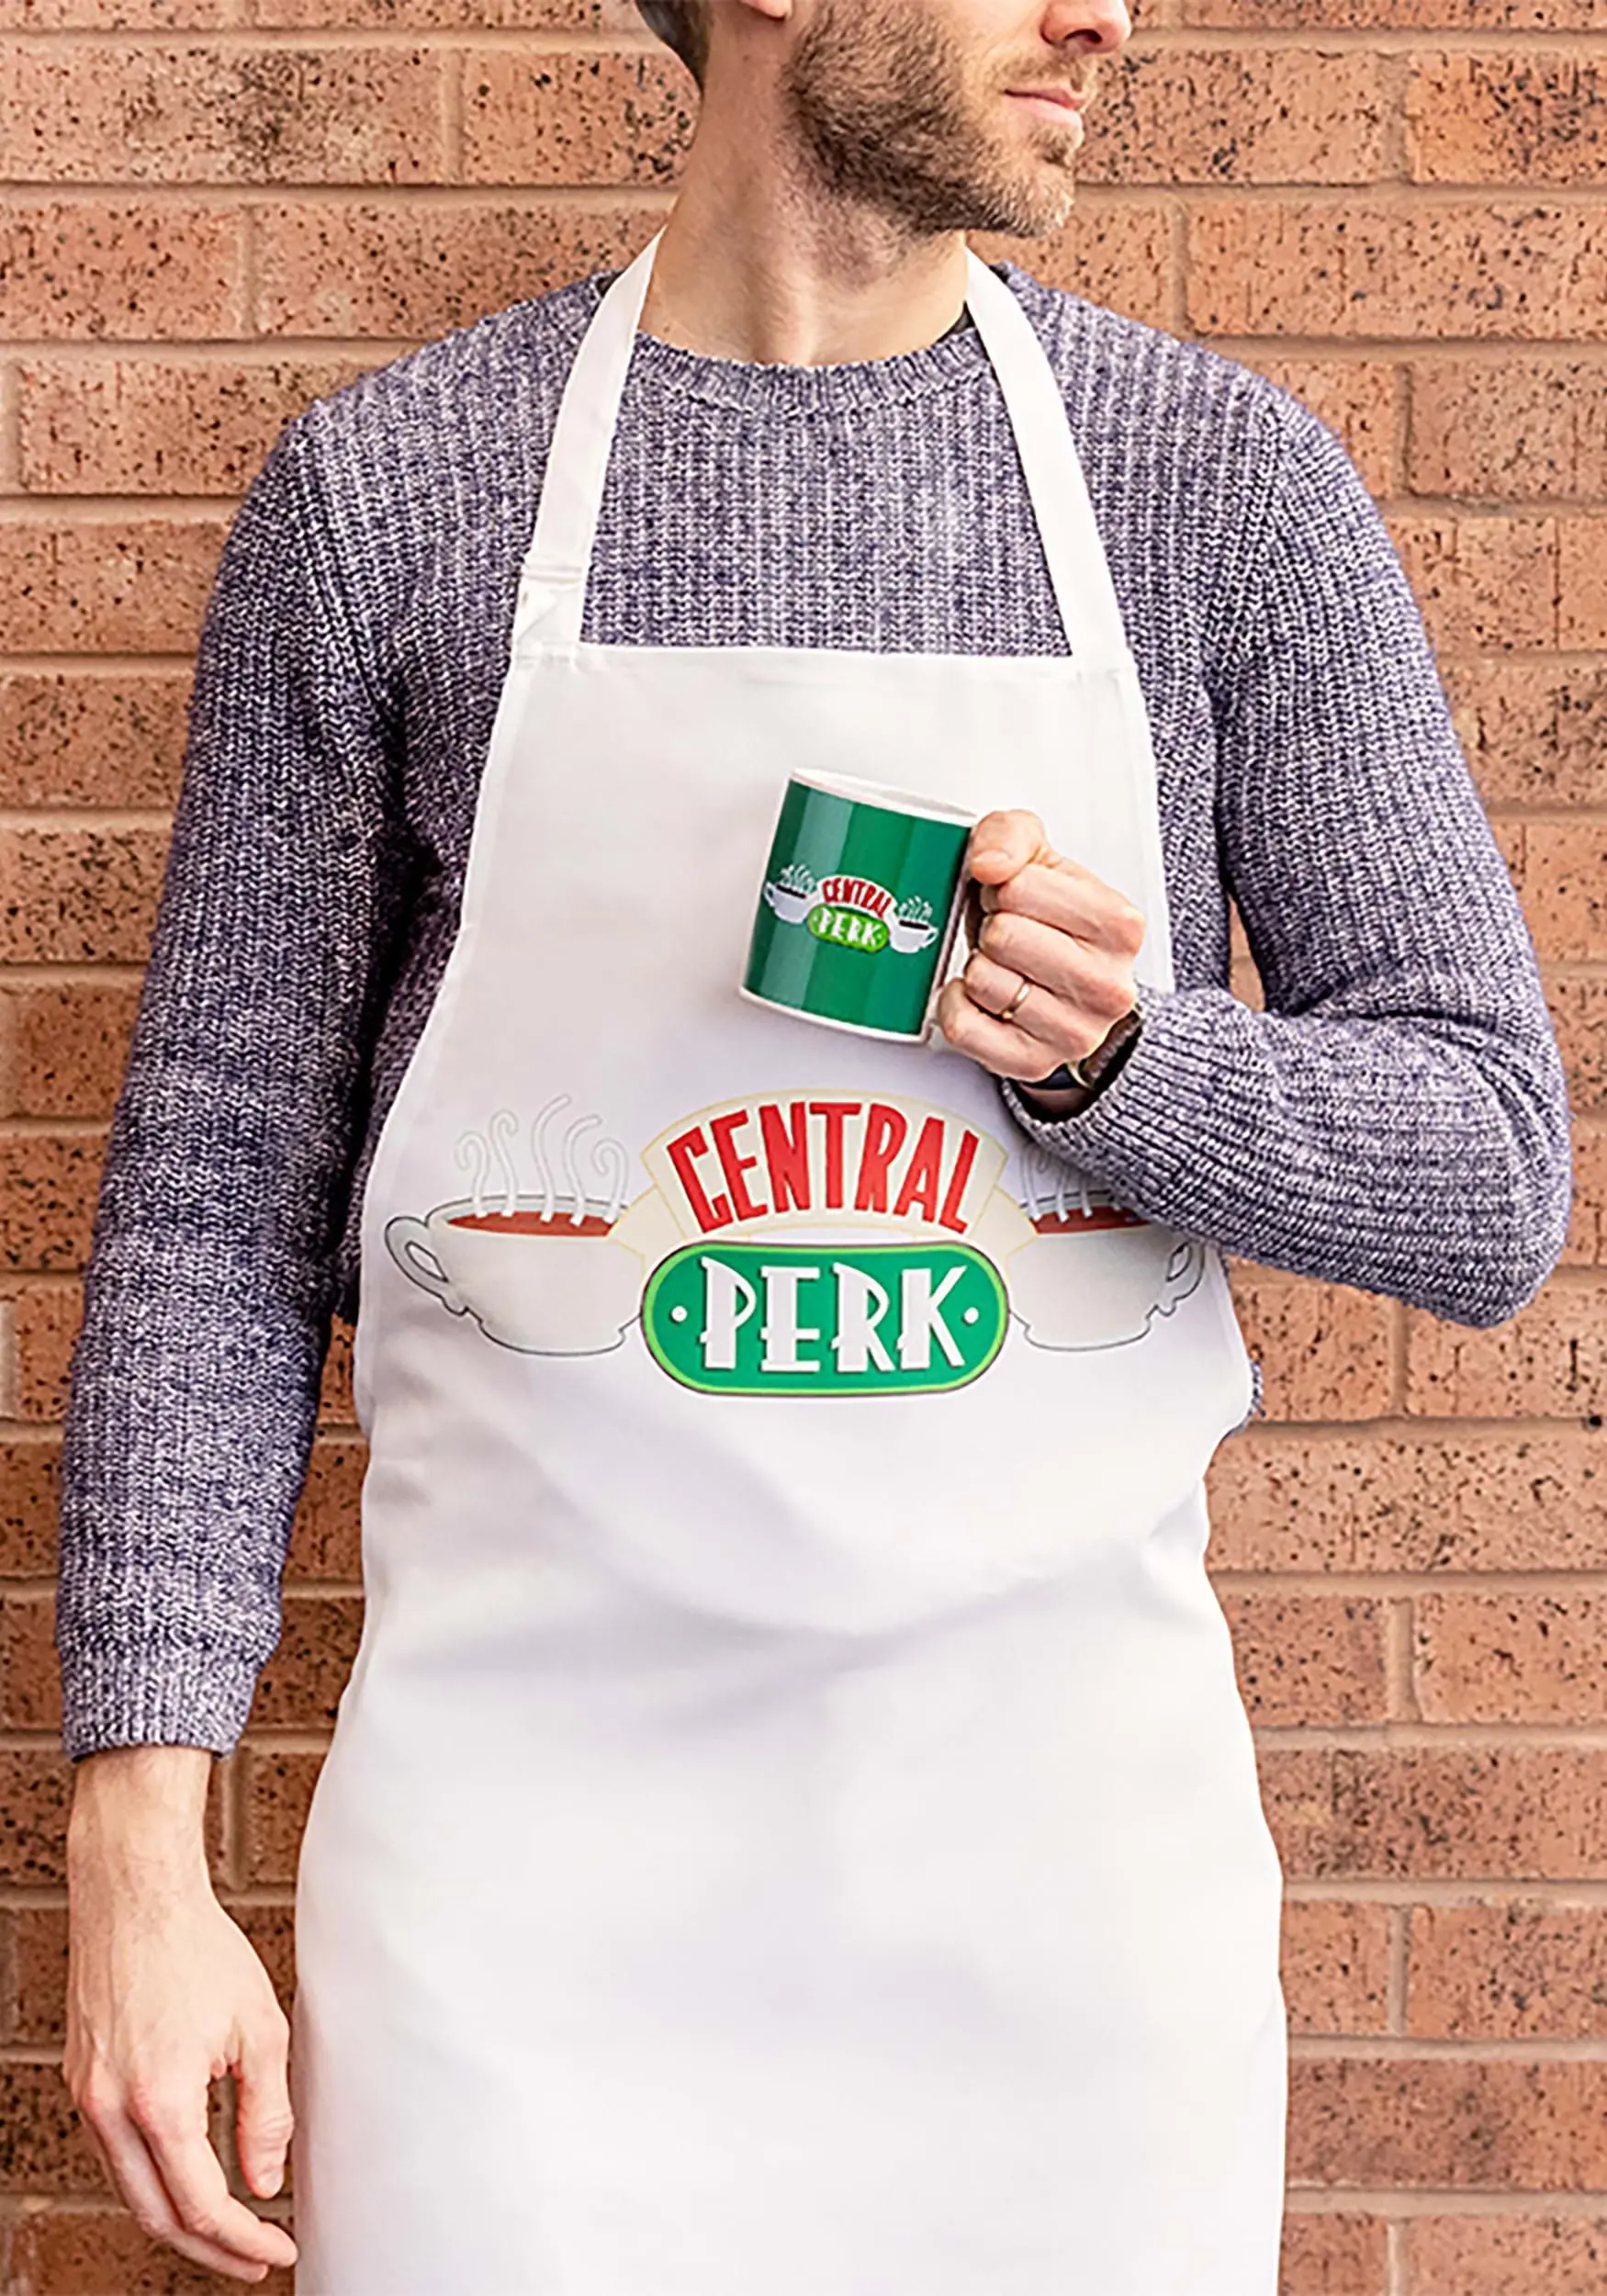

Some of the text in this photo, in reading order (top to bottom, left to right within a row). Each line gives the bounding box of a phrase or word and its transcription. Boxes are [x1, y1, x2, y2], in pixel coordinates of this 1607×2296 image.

[818, 908, 881, 944] PERK
[822, 877, 893, 917] CENTRAL
[666, 1101, 980, 1234] CENTRAL
[699, 1255, 967, 1374] PERK
